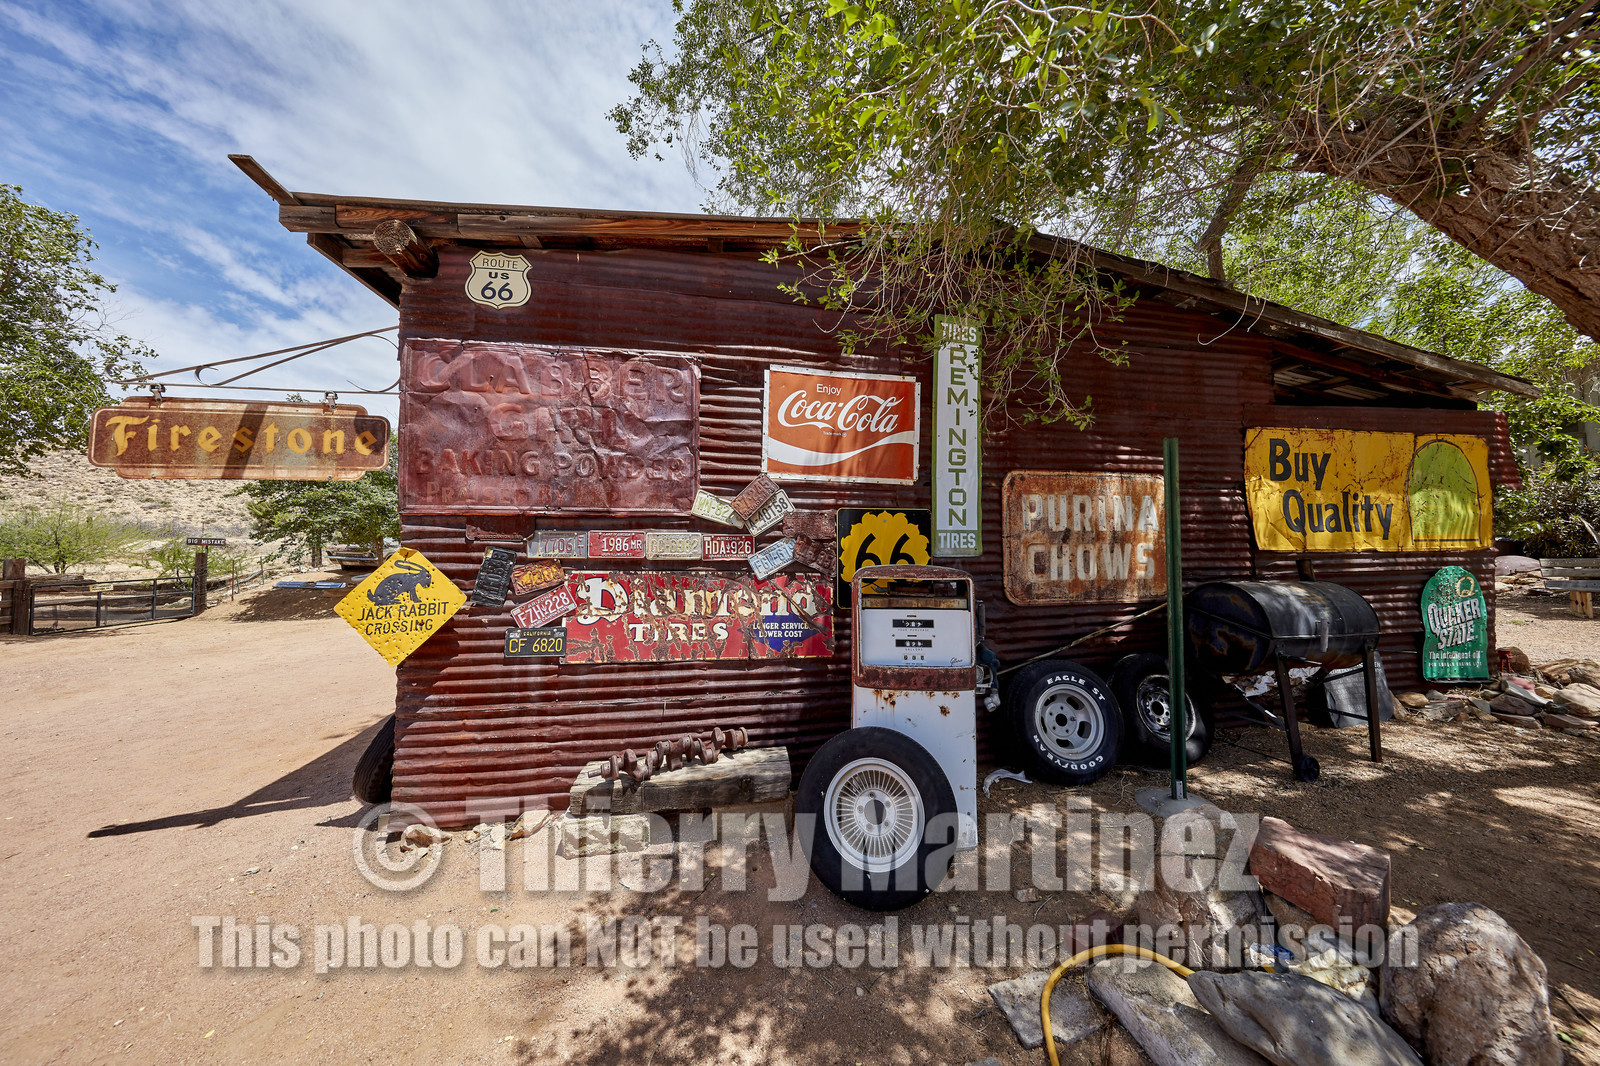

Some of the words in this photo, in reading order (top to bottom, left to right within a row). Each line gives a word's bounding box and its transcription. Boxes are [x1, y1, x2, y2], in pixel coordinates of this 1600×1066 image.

[482, 257, 518, 270] ROUTE
[488, 271, 510, 280] US
[480, 280, 513, 301] 66
[941, 322, 977, 342] TIRES
[417, 351, 686, 403] CLABBER
[816, 383, 842, 397] Enjoy
[777, 389, 904, 434] Coca-Cola
[104, 414, 378, 457] Firestone
[947, 346, 968, 527] REMINGTON
[415, 448, 541, 477] BAKING
[552, 451, 685, 482] POWDER
[1268, 438, 1332, 491] Buy
[538, 483, 567, 505] BY
[1022, 494, 1160, 532] PURINA
[1282, 489, 1394, 540] Quality
[542, 538, 572, 552] 7706
[602, 538, 629, 552] 1986
[630, 540, 642, 550] MR
[705, 540, 726, 555] HDA
[731, 541, 752, 554] 926
[855, 532, 915, 567] 66
[938, 532, 976, 550] TIRES
[1027, 543, 1155, 583] CHOWS
[1456, 576, 1476, 598] Q
[357, 606, 392, 622] JACK
[398, 602, 449, 618] RABBIT
[518, 604, 545, 628] FZH
[545, 592, 570, 614] 228
[528, 594, 552, 608] ARIZONA
[365, 618, 434, 636] CROSSING
[753, 622, 780, 630] LONGER
[781, 622, 809, 630] SERVICE
[1427, 598, 1482, 638] QUAKER
[628, 621, 728, 642] TIRES
[758, 630, 783, 638] LOWER
[784, 630, 802, 638] COST
[1437, 620, 1475, 651] STATE
[509, 638, 528, 653] CF
[532, 638, 563, 652] 6820
[1428, 650, 1440, 660] The
[1047, 674, 1086, 686] EAGLE
[1092, 687, 1106, 702] ST
[1033, 734, 1104, 771] GOODYEAR
